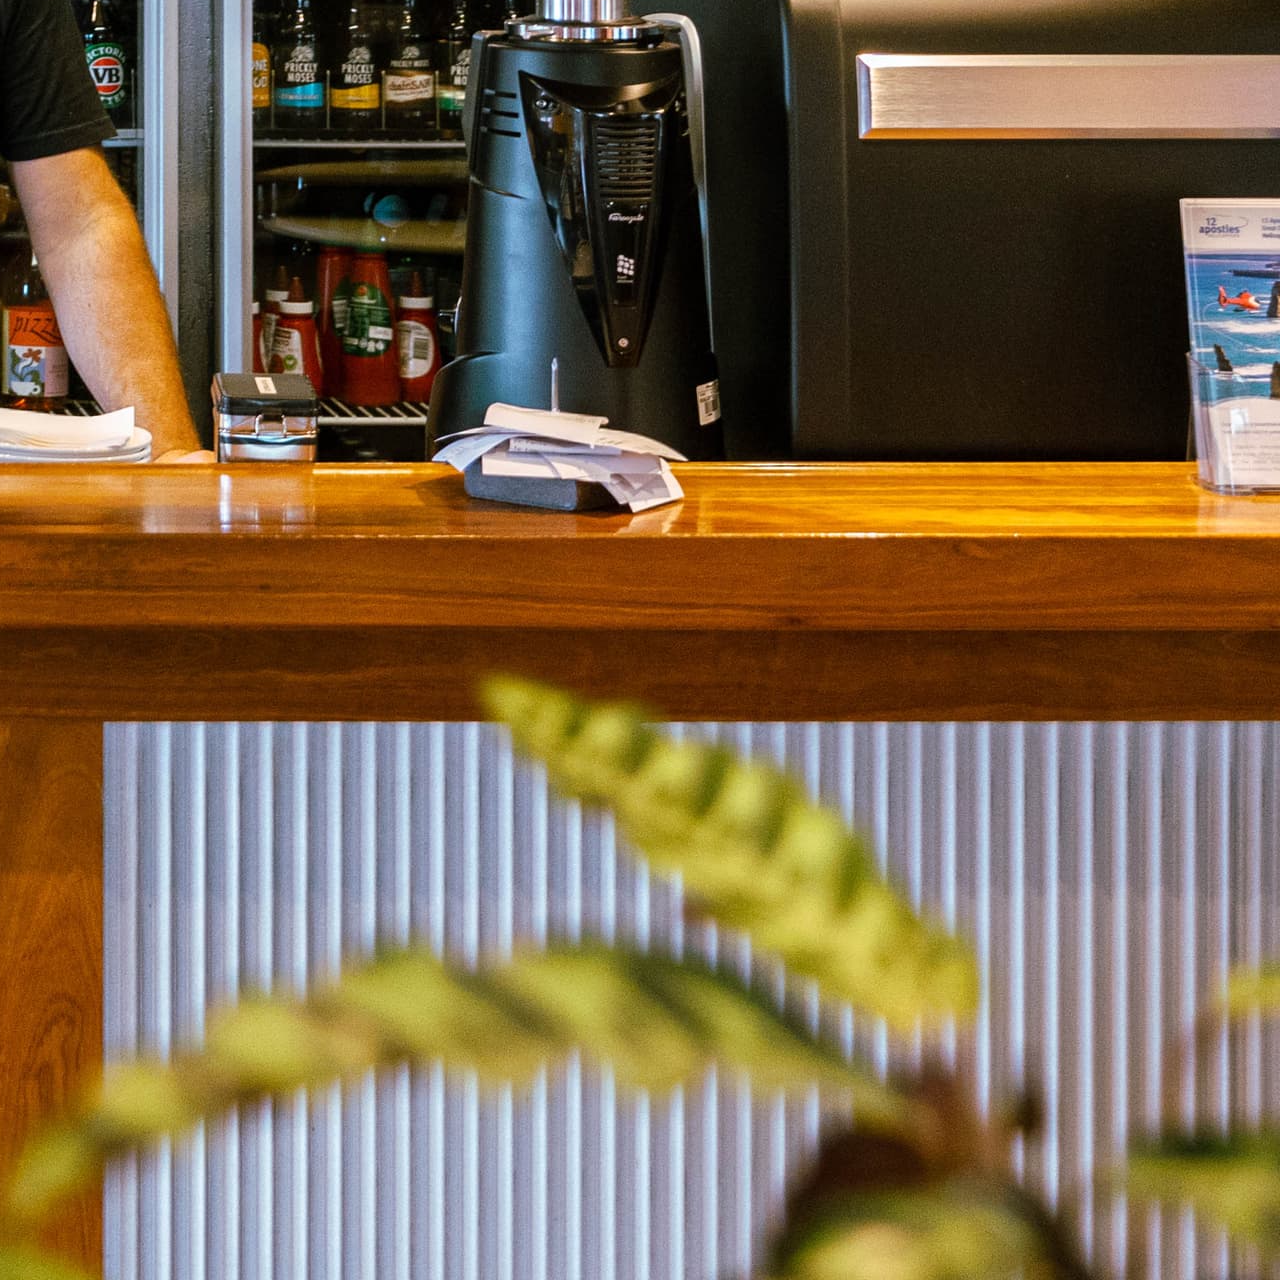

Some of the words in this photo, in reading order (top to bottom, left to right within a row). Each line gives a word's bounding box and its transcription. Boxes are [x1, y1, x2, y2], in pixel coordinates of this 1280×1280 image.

[284, 62, 318, 73] PRICKLY
[341, 63, 375, 74] PRICKLY
[450, 65, 469, 75] PRIC
[93, 67, 121, 85] VB
[287, 73, 316, 83] MOSES
[343, 73, 373, 84] MOSES
[1199, 224, 1240, 236] apostles
